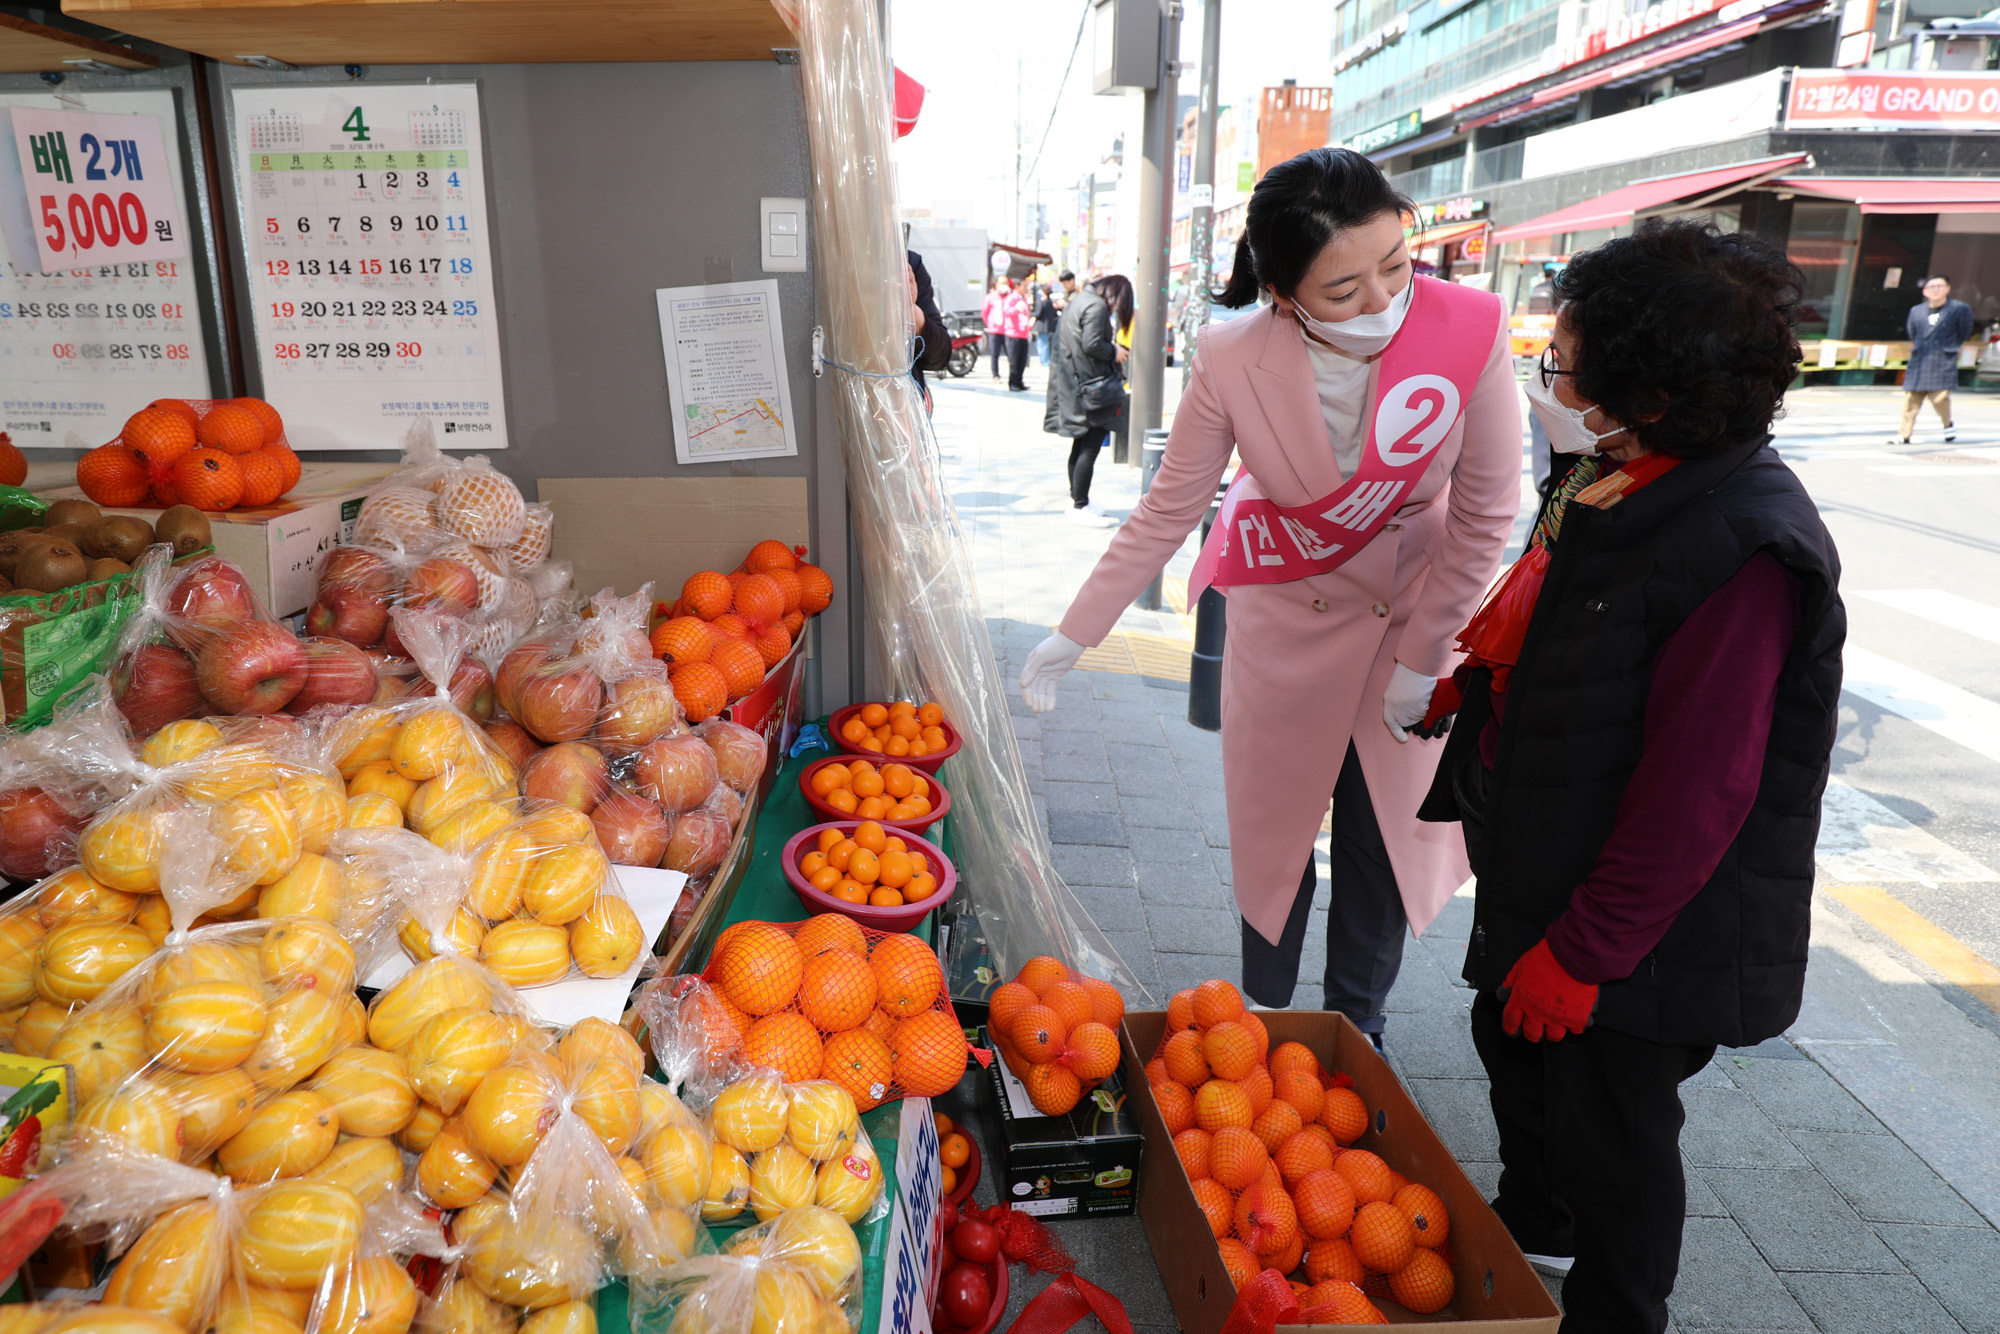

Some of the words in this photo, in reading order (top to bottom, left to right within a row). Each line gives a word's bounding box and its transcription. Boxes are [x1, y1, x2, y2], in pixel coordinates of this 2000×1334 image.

[1882, 87, 1974, 112] GRAND
[1978, 88, 2000, 112] O
[342, 106, 370, 141] 4
[29, 131, 74, 183] 배
[80, 133, 143, 181] 2개
[262, 156, 270, 165] 日
[292, 155, 300, 165] 月
[323, 155, 332, 164] 火
[355, 154, 364, 164] 水
[386, 153, 395, 163] 木
[416, 153, 425, 162] 金
[448, 152, 456, 162] 土
[357, 173, 367, 188] 1
[386, 172, 398, 188] 2
[417, 171, 429, 188] 3
[447, 171, 460, 187] 4
[40, 192, 148, 259] 5,000
[155, 220, 173, 241] 원
[267, 218, 279, 233] 5
[298, 217, 310, 233] 6
[329, 217, 341, 232] 7
[360, 216, 372, 232] 8
[390, 216, 402, 231] 9
[415, 215, 438, 230] 10
[446, 216, 468, 230] 11
[266, 260, 290, 275] 12
[297, 260, 320, 275] 13
[328, 260, 352, 274] 14
[359, 259, 382, 274] 15
[389, 258, 411, 274] 16
[419, 258, 441, 273] 17
[449, 258, 472, 273] 18
[271, 302, 294, 317] 19
[301, 302, 326, 317] 20
[333, 302, 356, 316] 21
[362, 301, 385, 316] 22
[392, 301, 416, 316] 23
[423, 301, 447, 315] 24
[453, 301, 477, 316] 25
[275, 343, 300, 358] 26
[306, 343, 329, 358] 27
[336, 343, 360, 358] 28
[366, 342, 390, 357] 29
[396, 342, 422, 357] 30
[381, 402, 429, 410] 보령제약그룹의
[432, 402, 460, 410] 헬스케어
[462, 402, 489, 410] 전문기업
[457, 423, 492, 432] 보령컨슈머
[1389, 388, 1445, 453] 2
[1238, 480, 1406, 568] 배현진
